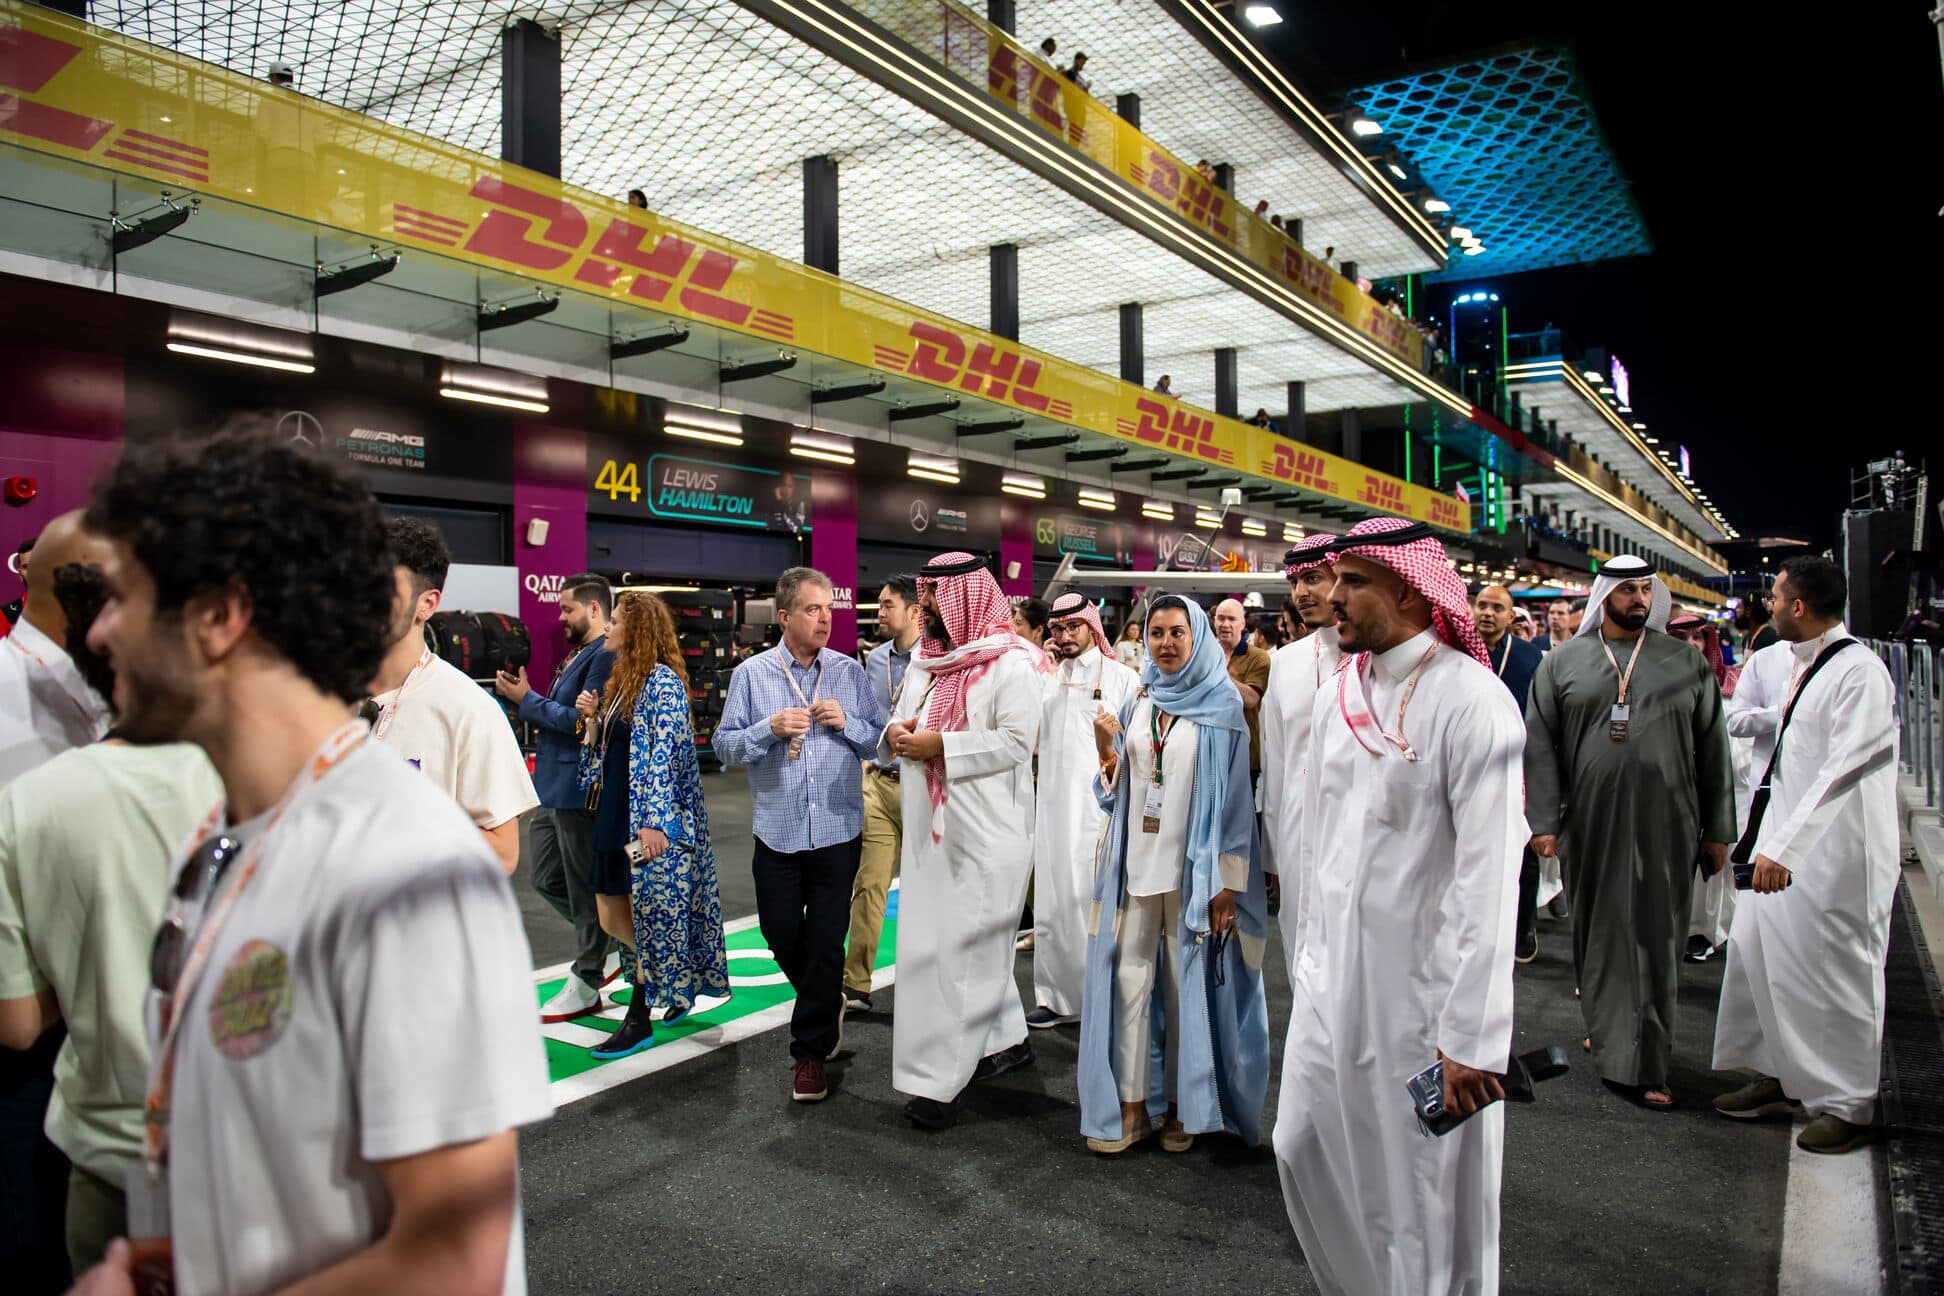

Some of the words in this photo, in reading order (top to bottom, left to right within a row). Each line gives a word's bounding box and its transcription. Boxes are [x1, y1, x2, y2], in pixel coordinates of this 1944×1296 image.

[1148, 150, 1229, 237] DHL
[463, 175, 753, 325] DHL
[907, 321, 1050, 412] DHL
[1136, 397, 1220, 459] DHL
[336, 438, 425, 458] PETRONAS
[349, 452, 385, 463] FORMULA
[387, 457, 403, 466] ONE
[405, 459, 425, 468] TEAM
[595, 460, 641, 502] 44
[662, 467, 719, 491] LEWIS
[1273, 444, 1329, 490] DHL
[658, 488, 753, 515] HAMILTON
[1365, 474, 1404, 512] DHL
[1037, 518, 1056, 544] 63
[525, 574, 566, 594] QATA
[538, 591, 561, 603] AIRW
